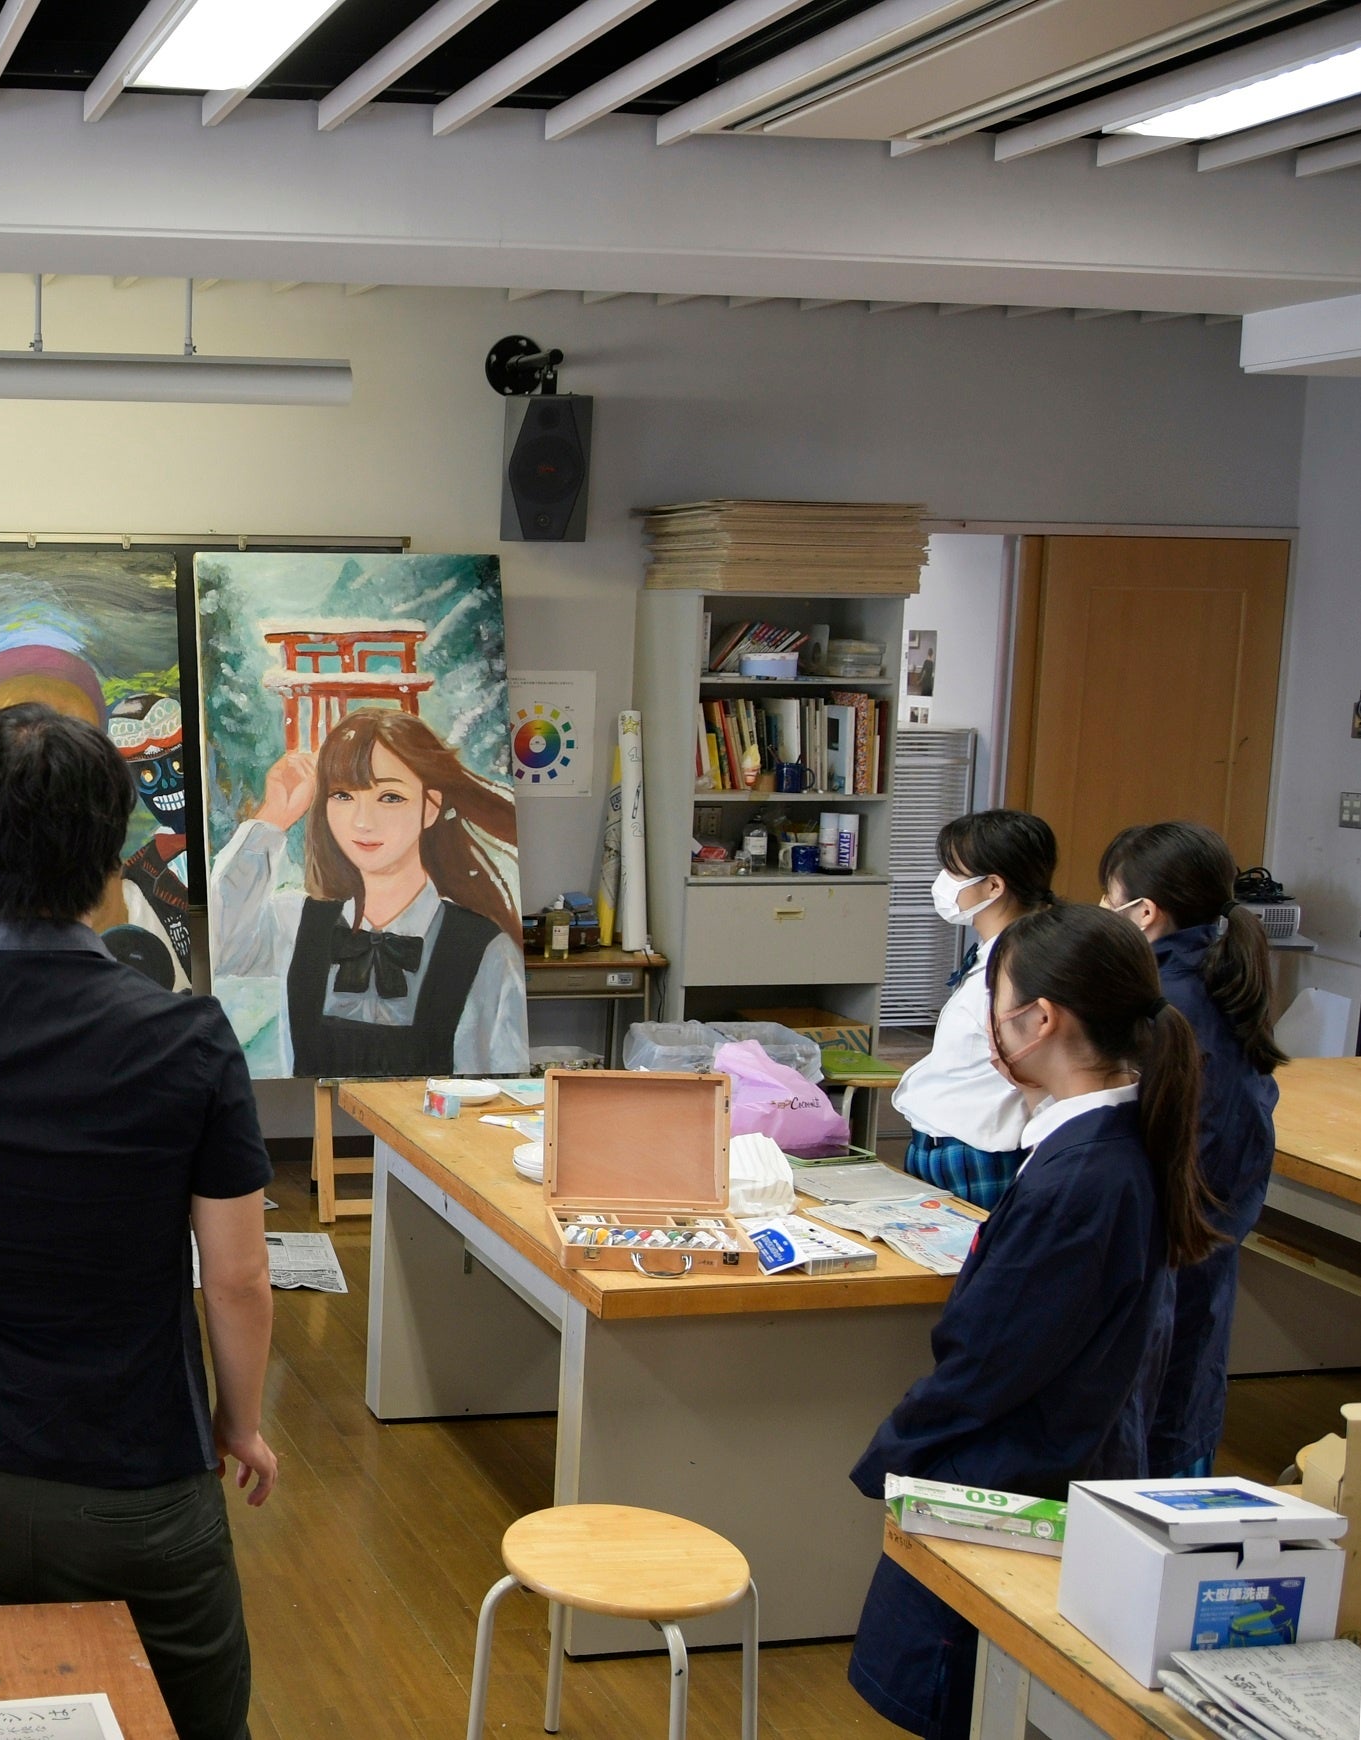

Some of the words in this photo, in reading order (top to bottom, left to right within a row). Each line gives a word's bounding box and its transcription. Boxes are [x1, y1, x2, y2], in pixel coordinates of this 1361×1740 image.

[1201, 1586, 1270, 1603] 大型筆洗器
